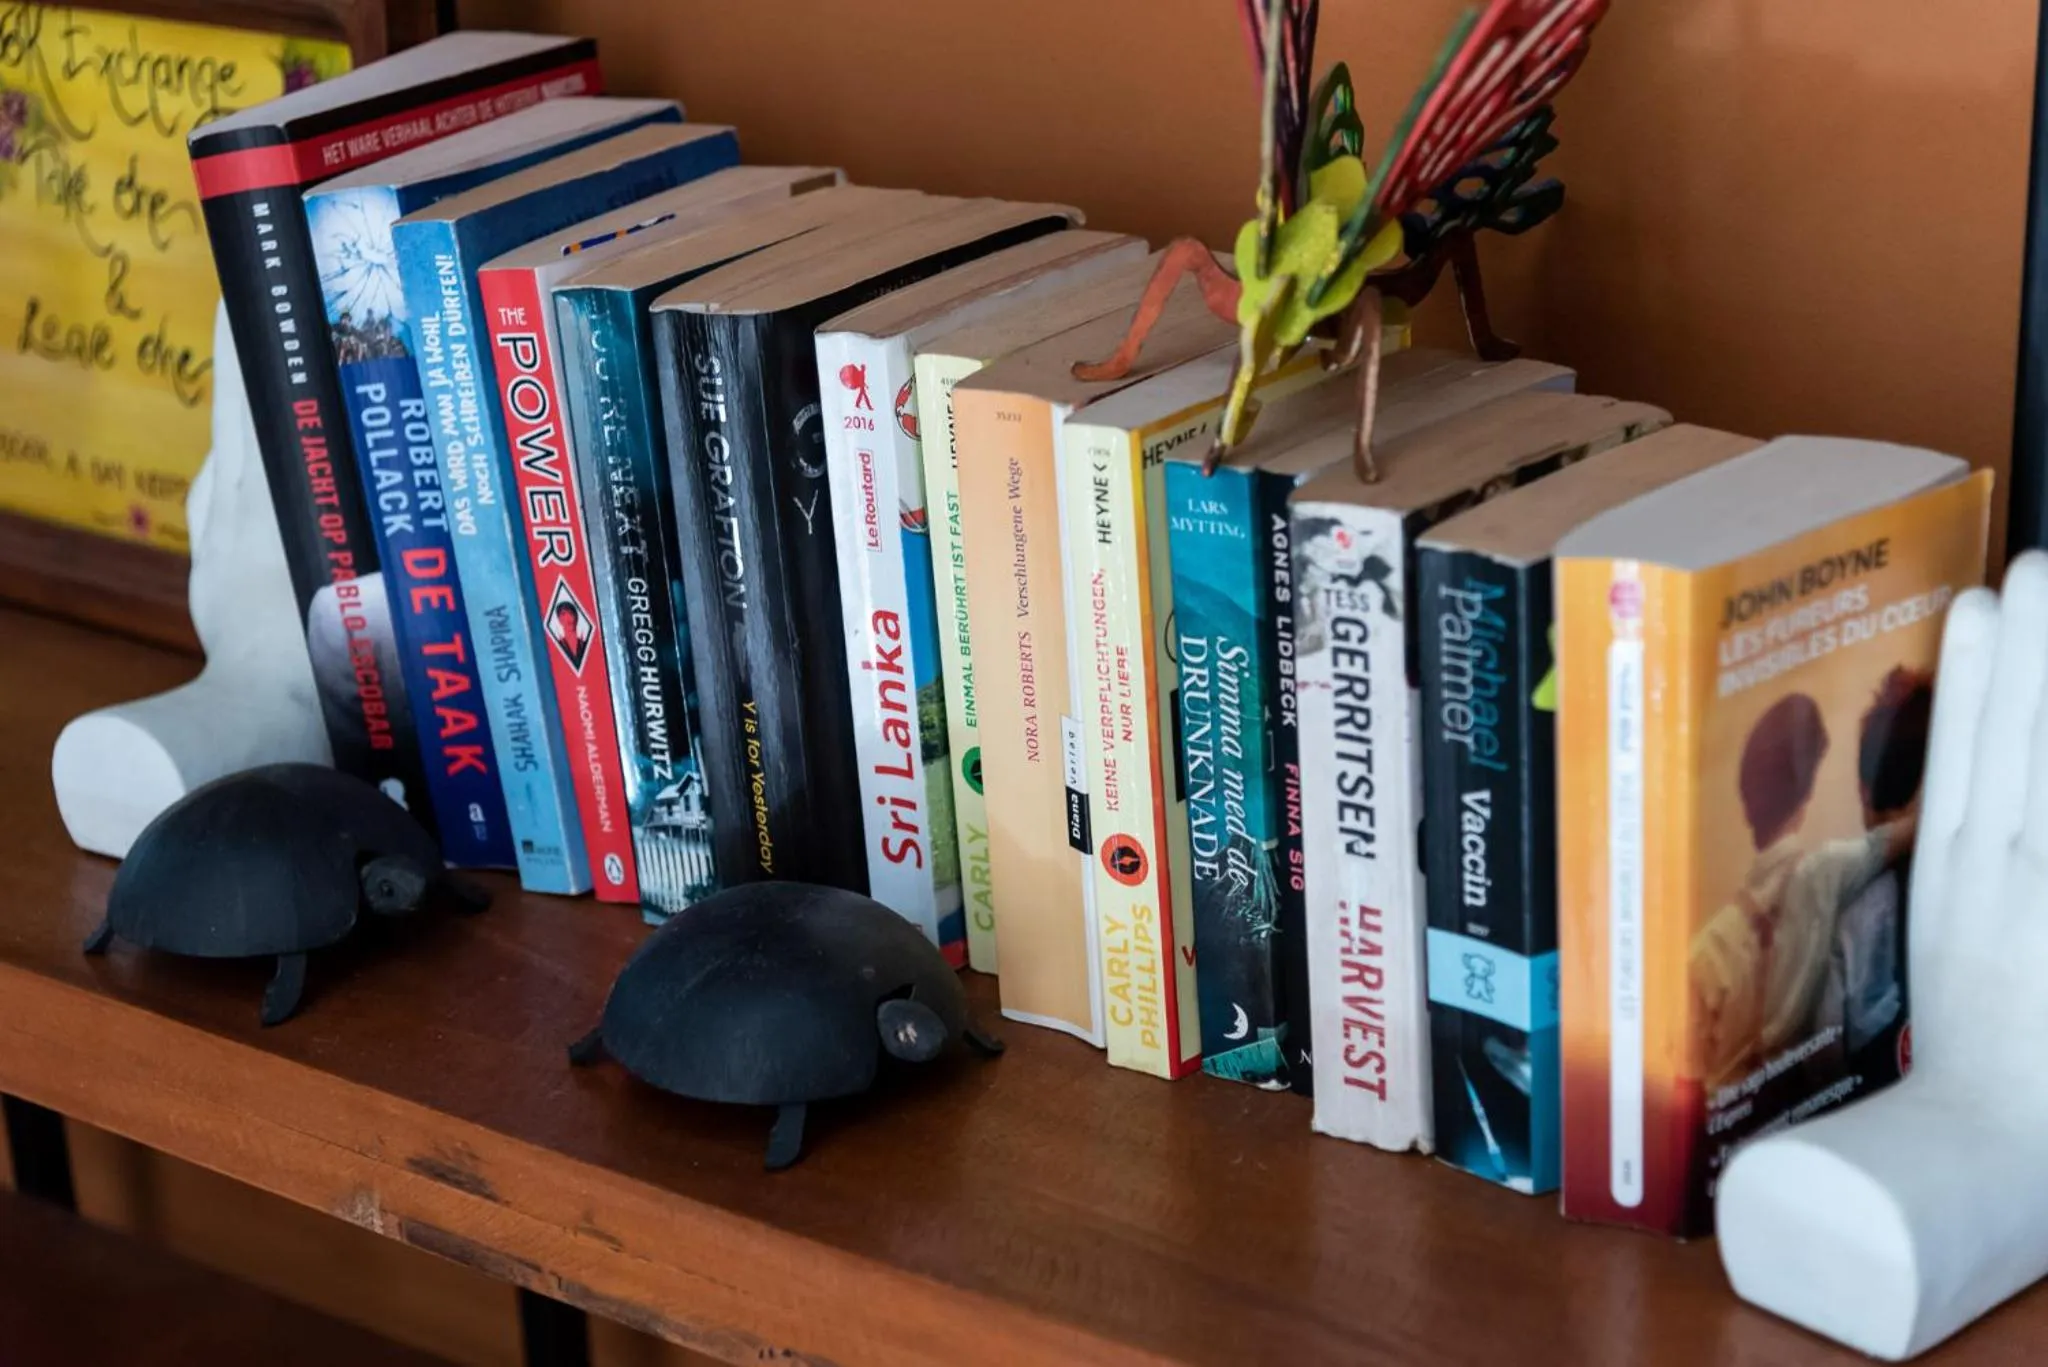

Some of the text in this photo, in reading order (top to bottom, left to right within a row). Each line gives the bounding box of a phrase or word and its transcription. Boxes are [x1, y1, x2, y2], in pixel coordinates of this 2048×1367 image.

[323, 140, 346, 166] HET
[347, 132, 382, 157] WARE
[381, 114, 433, 149] VERHAAL
[435, 254, 466, 337] DÜRFEN!
[428, 365, 454, 389] JA
[437, 393, 460, 437] MAN
[450, 344, 484, 447] SCHREIBEN
[496, 307, 577, 568] THE POWER
[844, 416, 875, 431] 2016
[252, 202, 394, 750] MARK BOWDEN DE JACHT OP PABLO ESCOBAR
[356, 382, 415, 538] POLLACK
[399, 398, 449, 533] ROBERT
[447, 440, 470, 491] WIRD
[453, 497, 477, 536] DAS
[694, 354, 748, 610] SUE GRAFTON
[1093, 476, 1112, 544] HEYNE
[1188, 498, 1228, 516] LARS
[947, 491, 977, 728] EINMAL BERÜHRT IST FAST
[1008, 457, 1040, 763] NORA ROBERTS Verschlungene Wege
[1272, 513, 1297, 728] AGNES LIDBECK
[1324, 588, 1370, 613] TESS
[1721, 538, 1891, 629] JOHN BOYNE
[1841, 616, 1878, 647] DU
[402, 546, 488, 776] DE TAAK
[484, 604, 539, 773] SHAHAK SHAPIRA
[628, 576, 674, 781] GREGG HURWITZ
[1120, 703, 1134, 742] NUR
[1464, 576, 1510, 772] Michael
[576, 685, 613, 833] NAOMI ALDERMAN
[743, 700, 774, 874] Y is for Yesterday
[861, 608, 922, 870] Sri Lanka
[1105, 758, 1120, 811] KEINE
[1180, 634, 1221, 882] DRUNKNADE
[1216, 635, 1257, 888] Simma med de
[1331, 616, 1377, 860] GERRITSEN
[966, 823, 995, 934] CARLY
[1071, 793, 1081, 840] Diana
[1284, 762, 1305, 892] FINNA SIG
[1461, 788, 1492, 908] Vaccin
[1104, 914, 1134, 1028] CARLY
[1131, 903, 1160, 1050] PHILLIPS
[1338, 900, 1388, 1102] HARVEST
